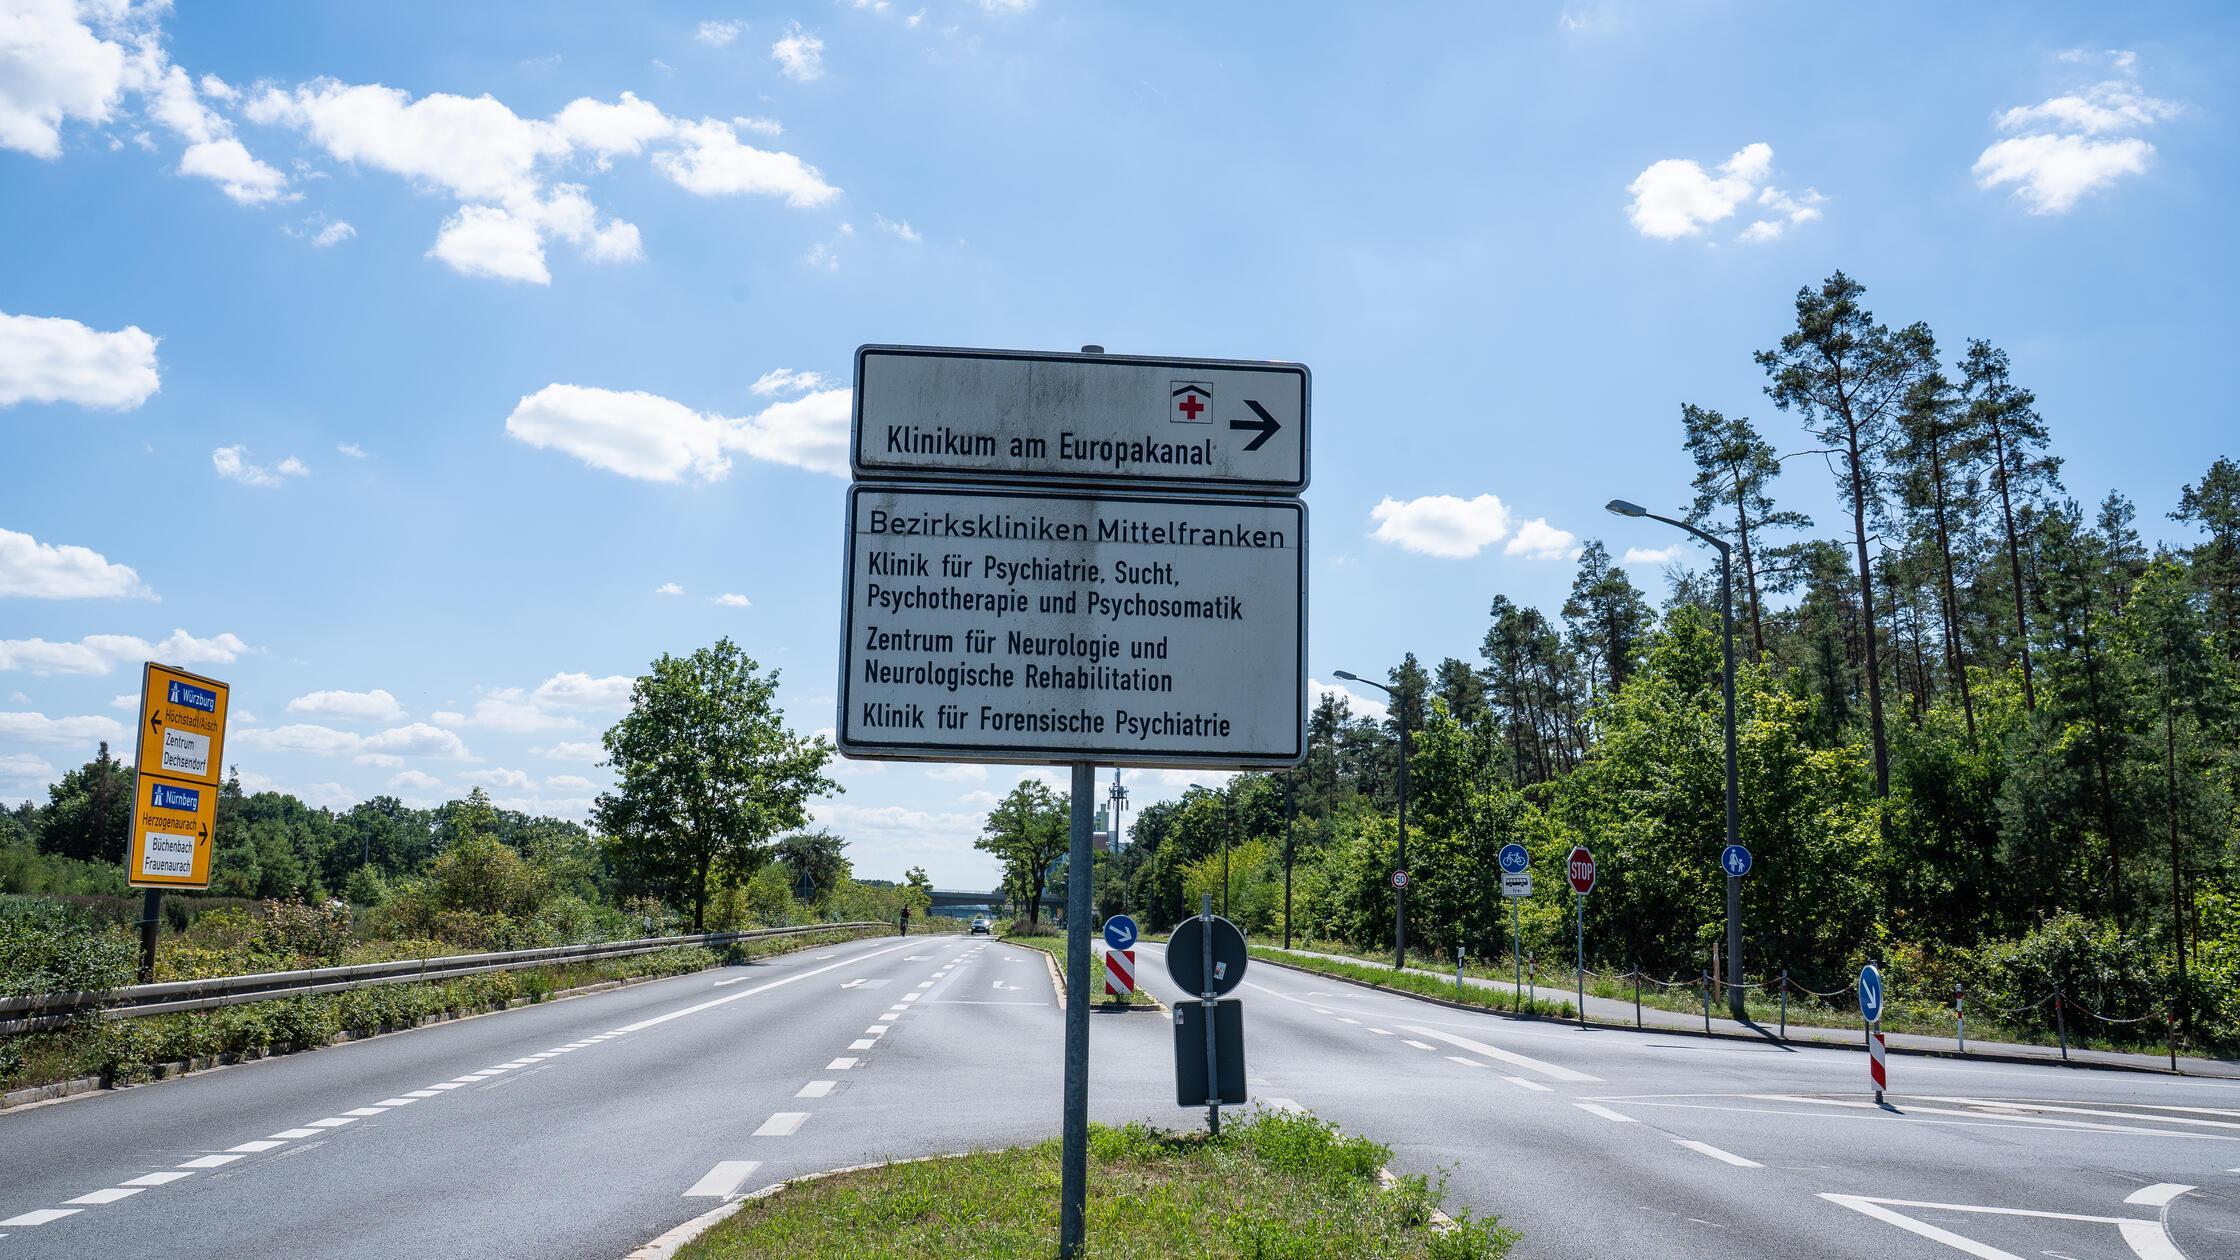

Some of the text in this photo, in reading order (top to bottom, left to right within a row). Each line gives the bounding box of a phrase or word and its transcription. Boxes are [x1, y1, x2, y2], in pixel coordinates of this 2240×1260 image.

[887, 425, 1212, 468] Klinikum am Europakanal
[870, 510, 1284, 548] Bezirkskliniken Mittelfranken
[869, 551, 1179, 587] Klinik für Psychiatrie, Sucht,
[868, 583, 1243, 621] Psychotherapie und Psychosomatik
[867, 626, 1168, 663] Zentrum für Neurologie und
[865, 659, 1172, 692] Neurologische Rehabilitation
[183, 688, 215, 711] Würzburg
[165, 708, 218, 732] Höchstadt/Aisch
[863, 703, 1231, 740] Klinik für Forensische Psychiatrie
[165, 732, 194, 750] Zentrum
[163, 751, 206, 771] Dechsendorf
[165, 790, 198, 811] Nürnberg
[142, 812, 197, 830] Herzogenaurach
[152, 837, 193, 854] Büchenbach
[144, 856, 191, 872] Frauenaurach
[1571, 861, 1593, 880] STOP
[1395, 875, 1406, 884] 50
